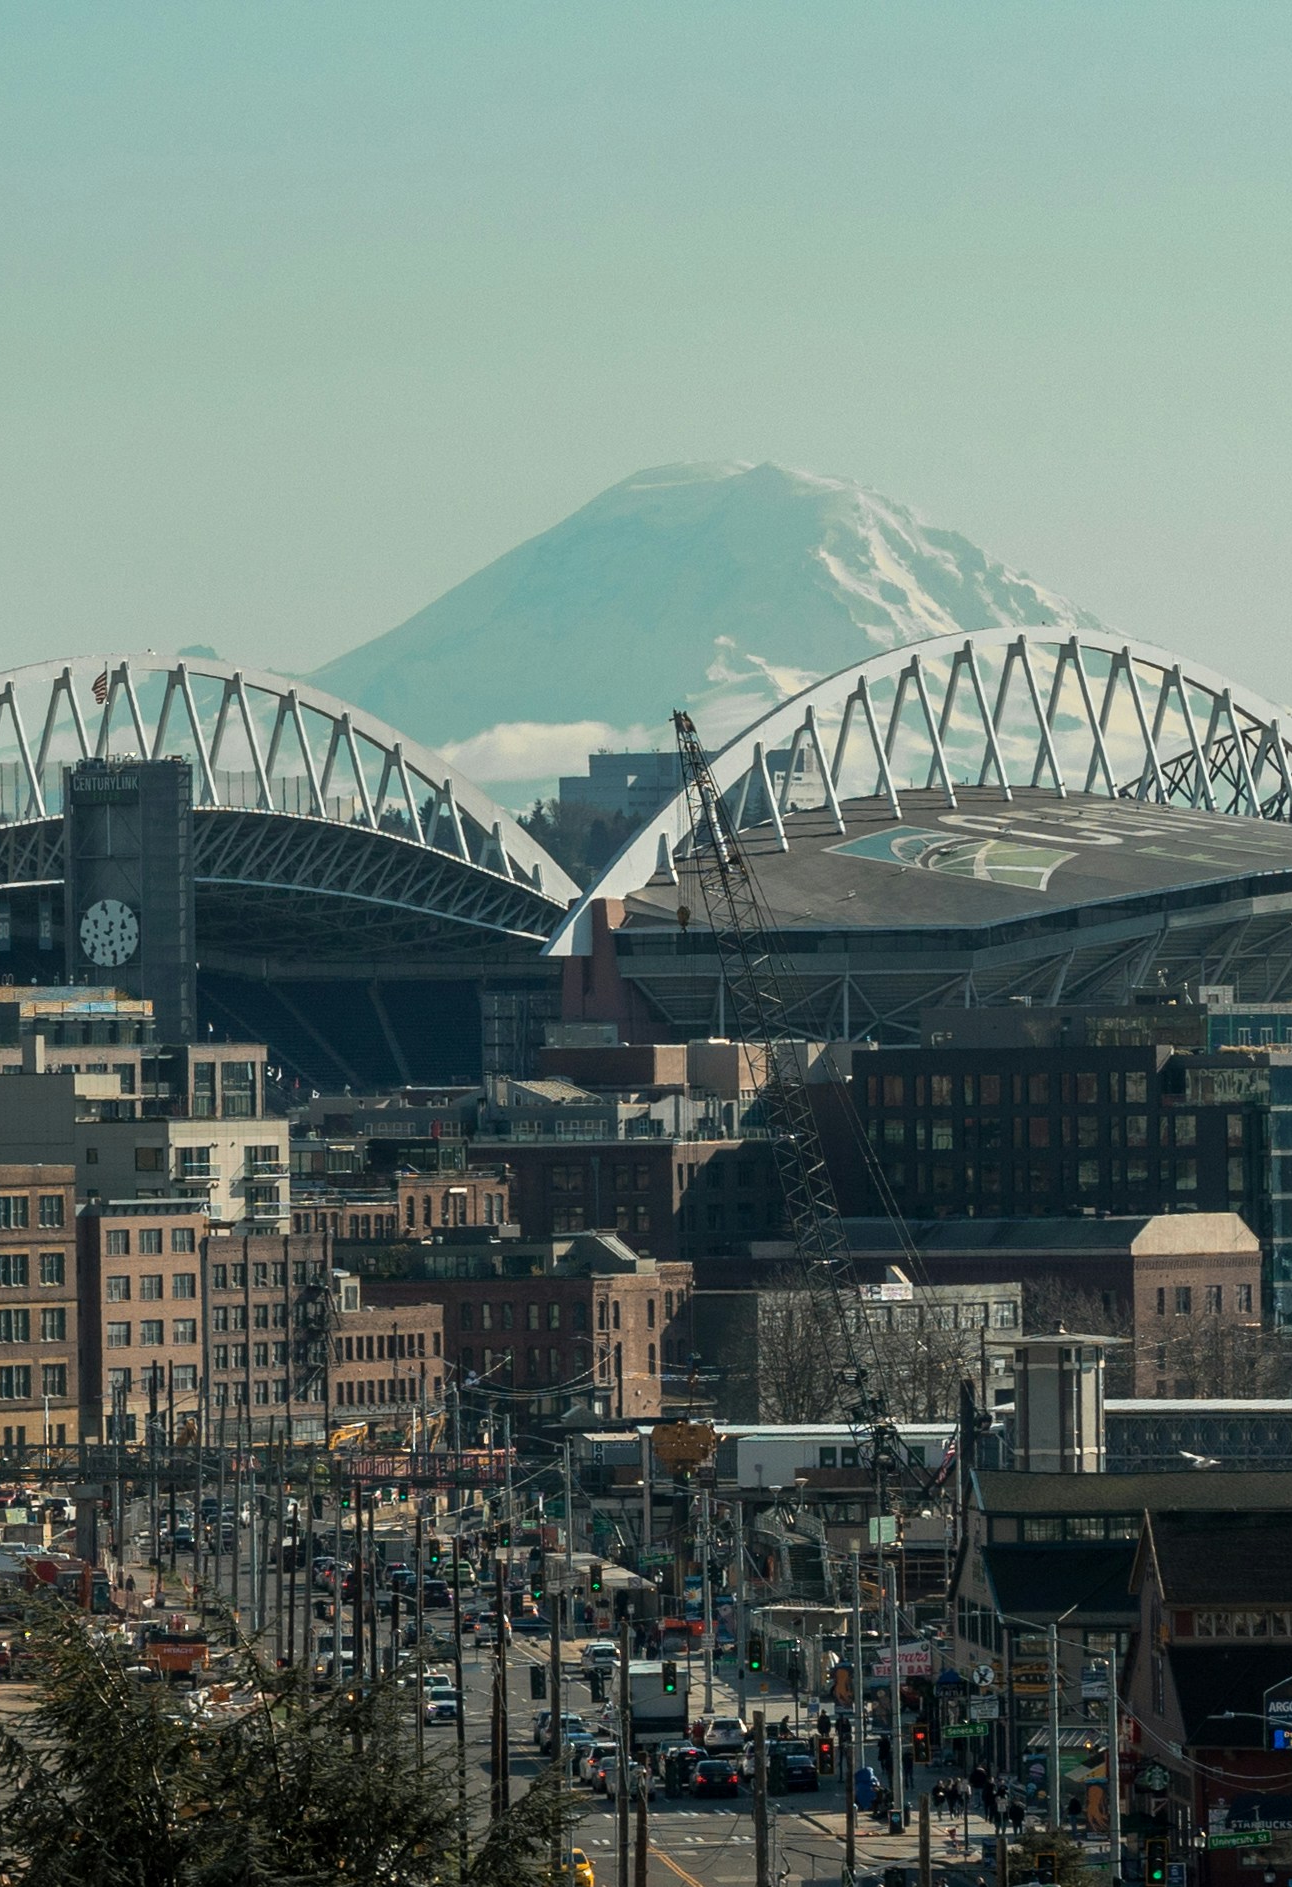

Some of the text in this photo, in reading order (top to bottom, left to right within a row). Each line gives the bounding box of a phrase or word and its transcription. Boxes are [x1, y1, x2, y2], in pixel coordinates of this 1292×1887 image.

[976, 1726, 985, 1734] St
[1230, 1819, 1292, 1830] STARBUCKS
[1211, 1833, 1268, 1847] University St
